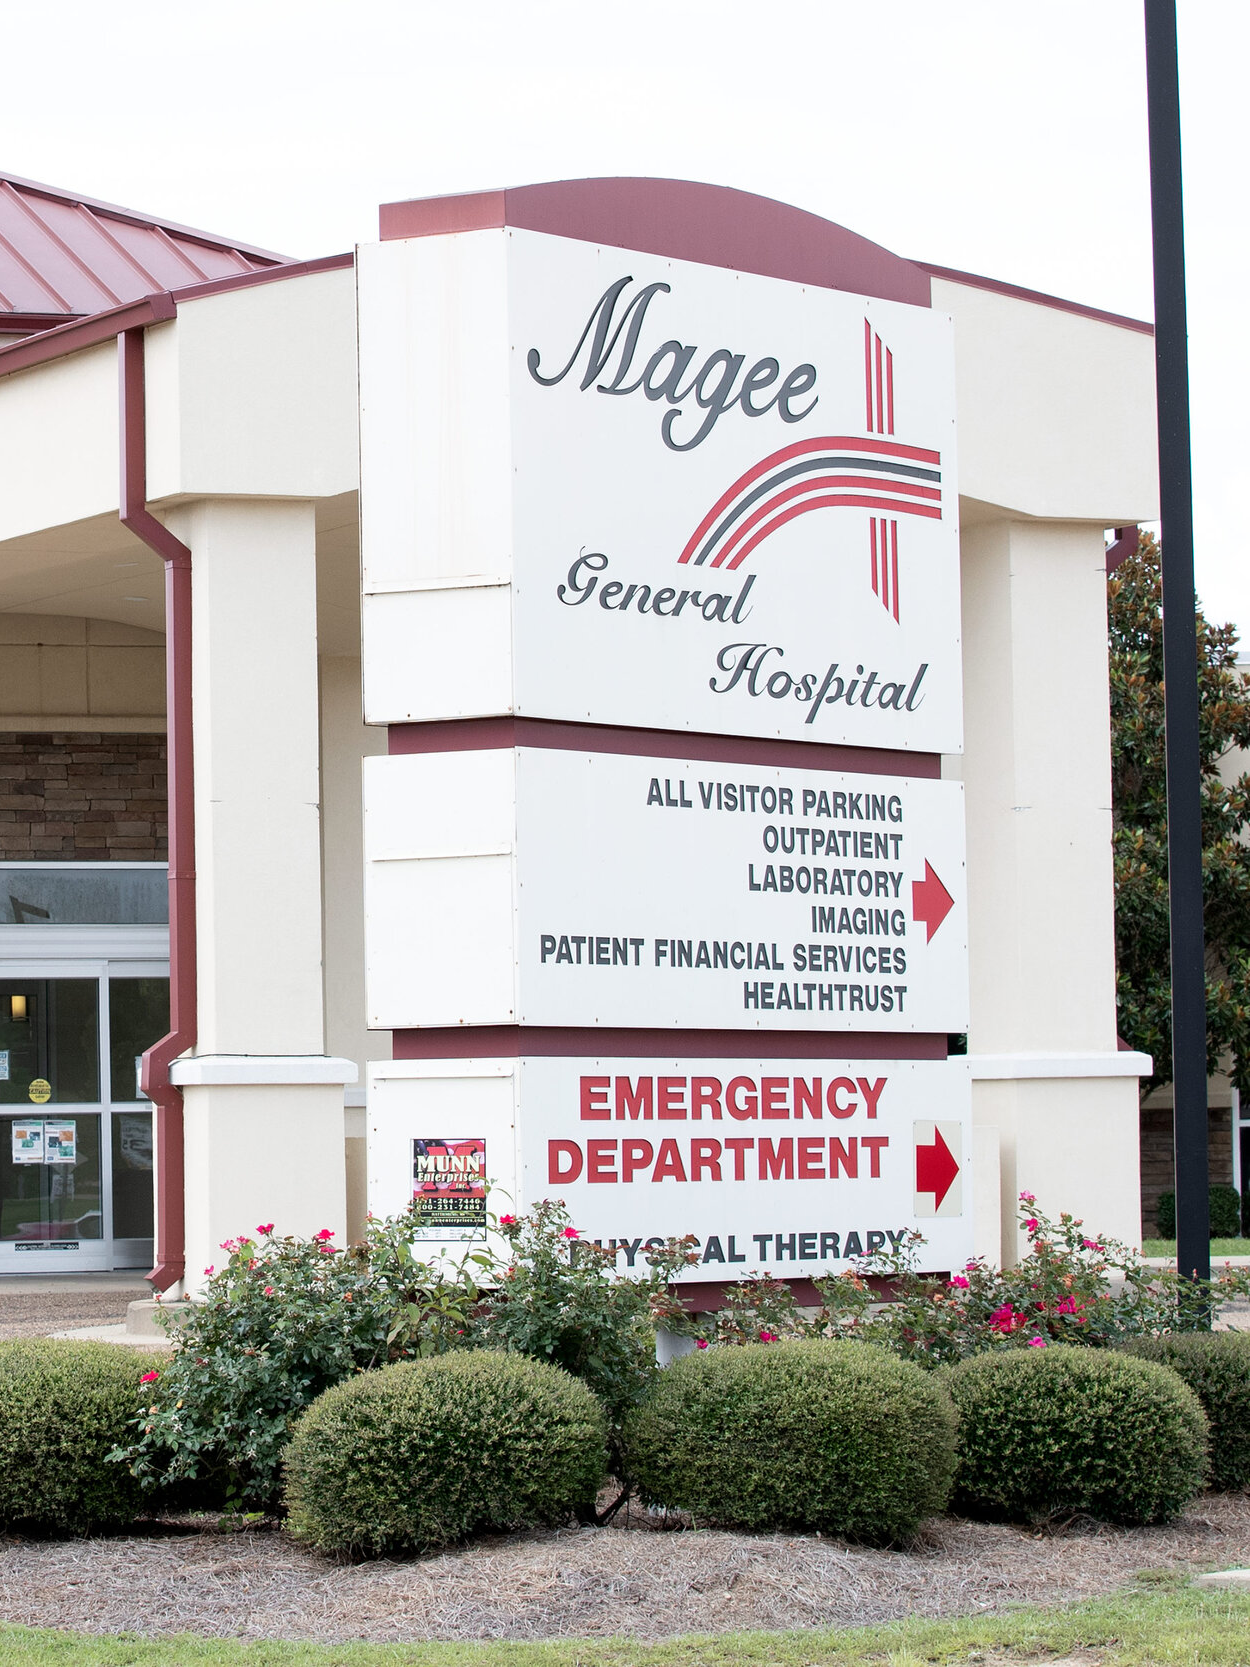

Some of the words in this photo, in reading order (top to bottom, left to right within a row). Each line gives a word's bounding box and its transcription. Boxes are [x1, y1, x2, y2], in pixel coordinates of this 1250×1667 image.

[528, 276, 819, 451] Magee
[556, 546, 756, 624] General
[709, 643, 928, 724] Hospital
[647, 778, 693, 808] ALL
[698, 782, 794, 816] VISITOR
[803, 789, 903, 823] PARKING
[763, 826, 903, 861] OUTPATIENT
[748, 864, 904, 899] LABORATORY
[811, 906, 906, 937] IMAGING
[541, 935, 645, 967] PATIENT
[654, 939, 785, 971] FINANCIAL
[793, 944, 907, 975] SERVICES
[744, 982, 908, 1013] HEALTHTRUST
[580, 1076, 888, 1121] EMERGENCY
[416, 1155, 480, 1172] MUNN
[418, 1172, 480, 1183] Enterprises
[548, 1137, 890, 1185] DEPARTMENT
[570, 1235, 746, 1268] PHYSAL
[753, 1230, 906, 1262] THERAPY
